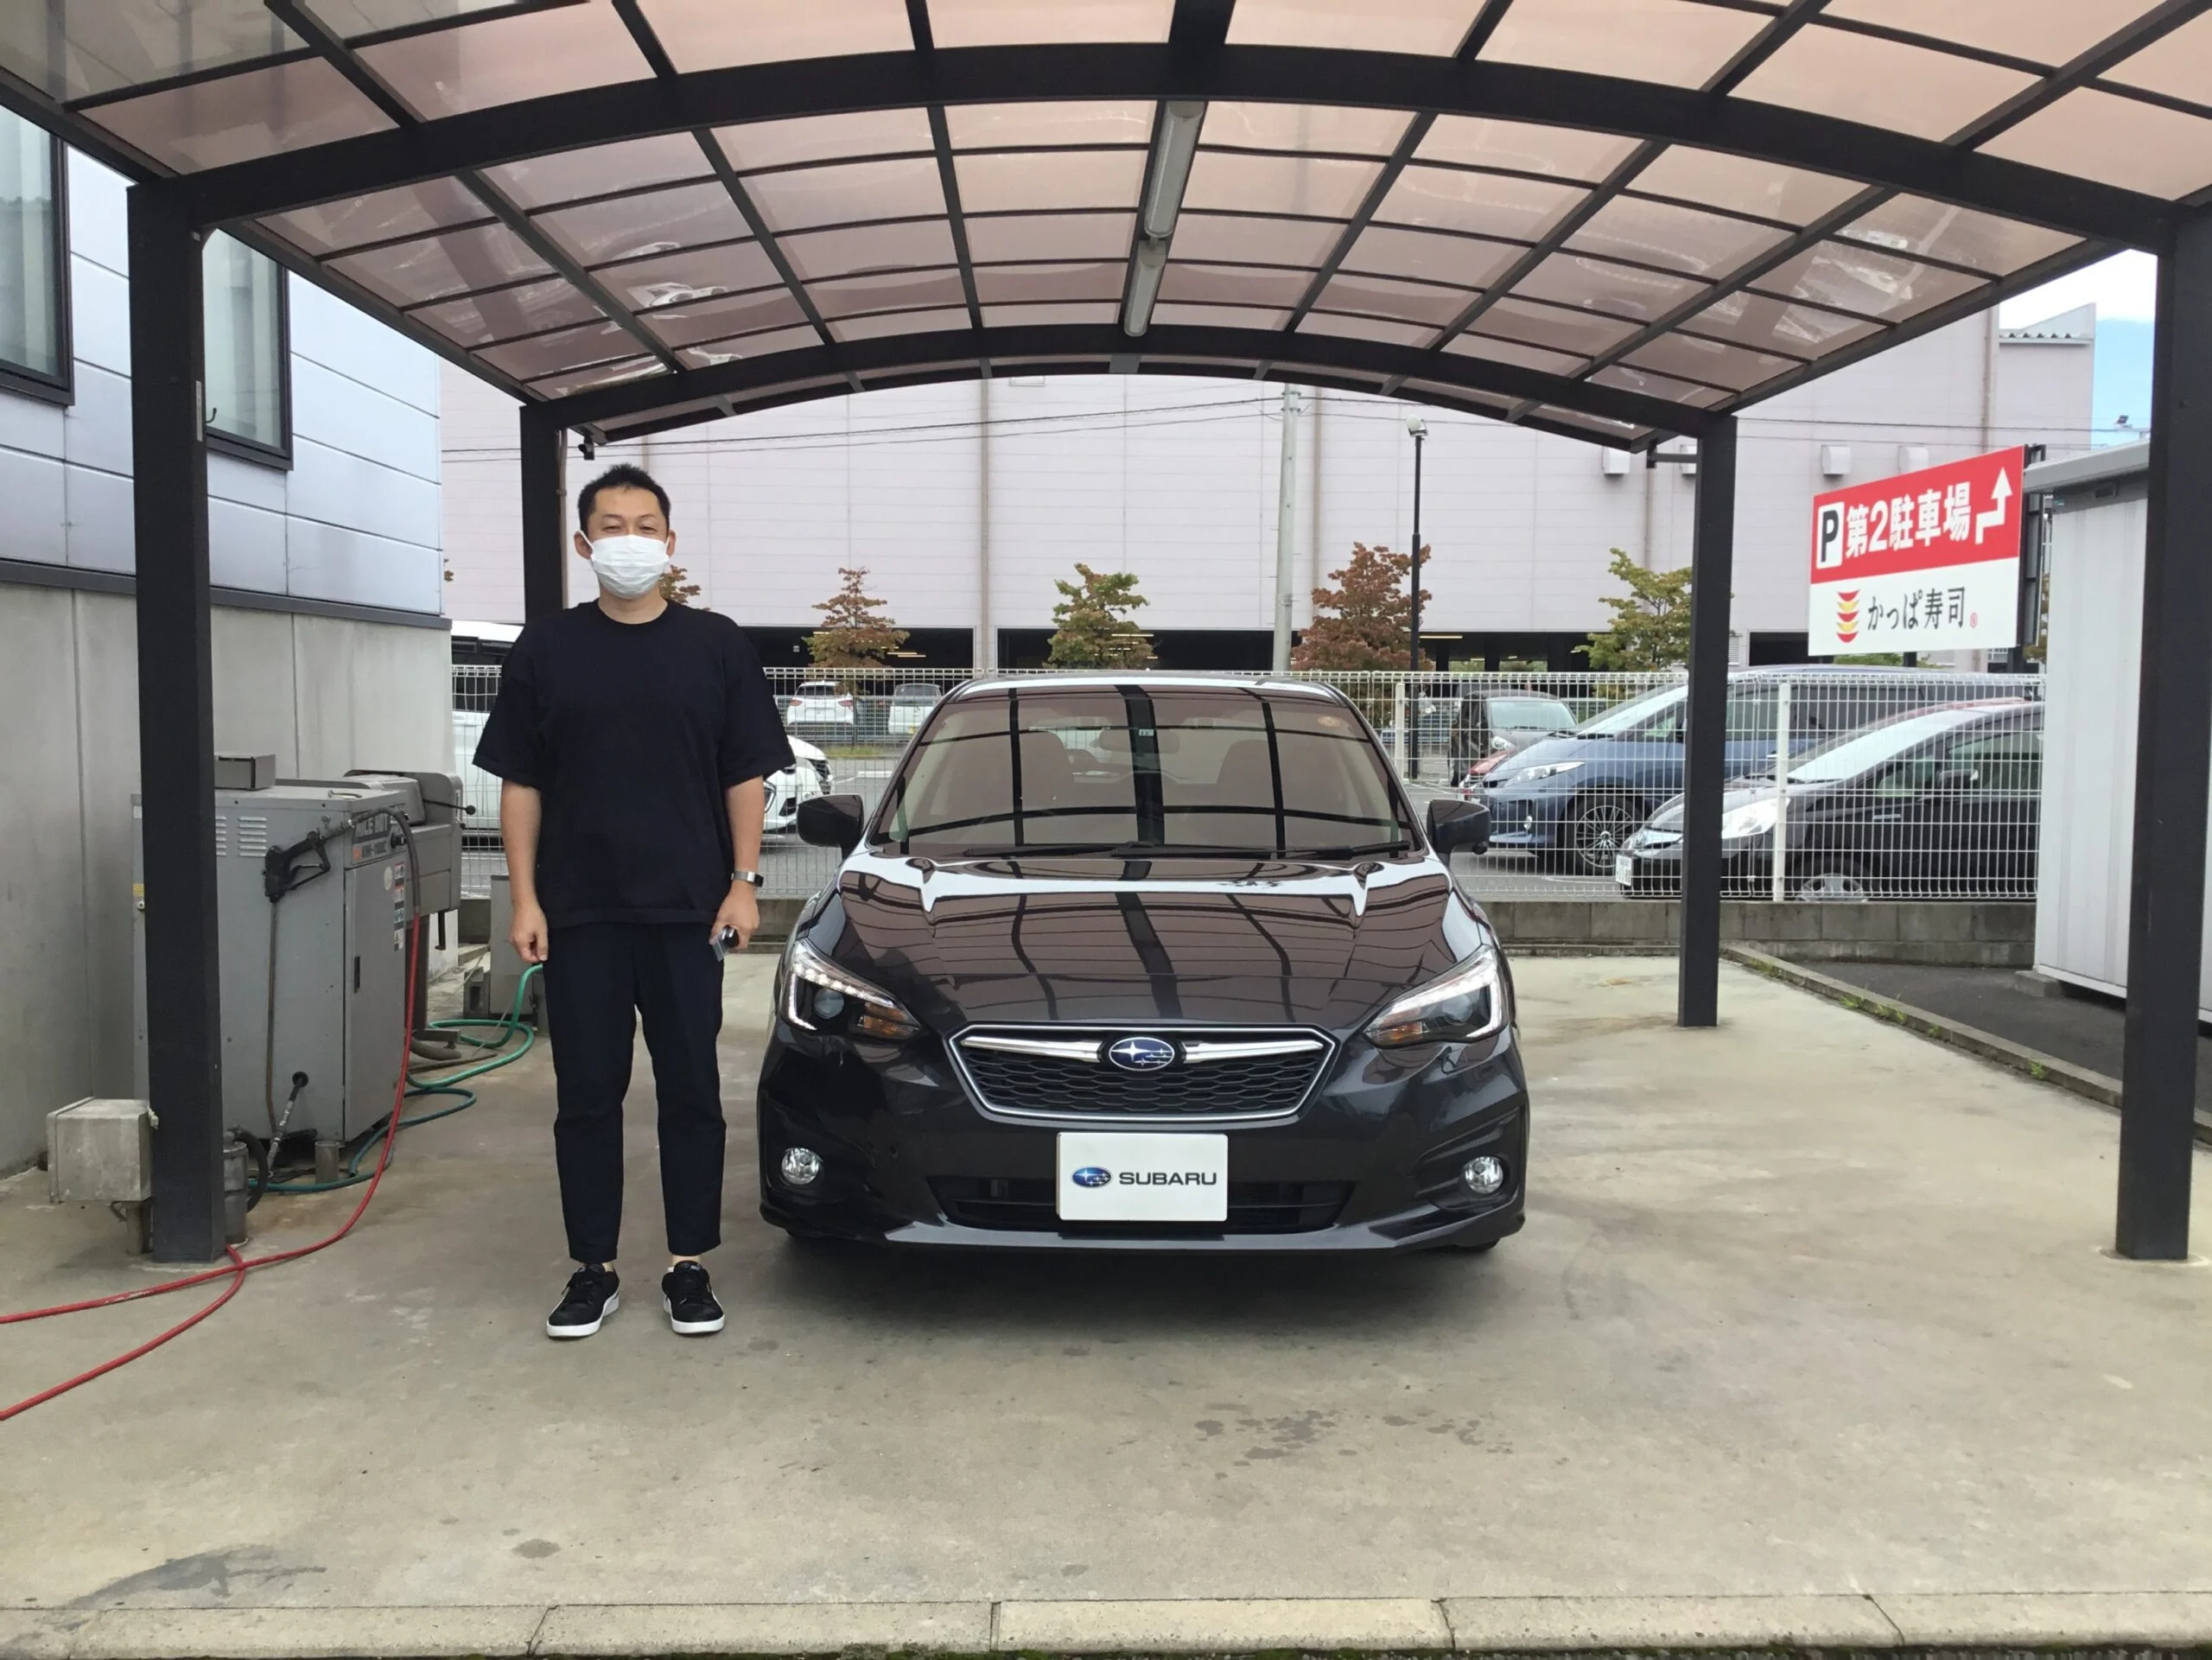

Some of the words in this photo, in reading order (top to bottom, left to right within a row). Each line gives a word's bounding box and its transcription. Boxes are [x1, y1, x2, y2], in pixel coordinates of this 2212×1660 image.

[1821, 509, 1840, 563] P
[1846, 481, 1972, 559] 第2駐車場
[1867, 586, 1966, 631] かっぱ寿司
[1119, 1172, 1217, 1186] SUBARU
